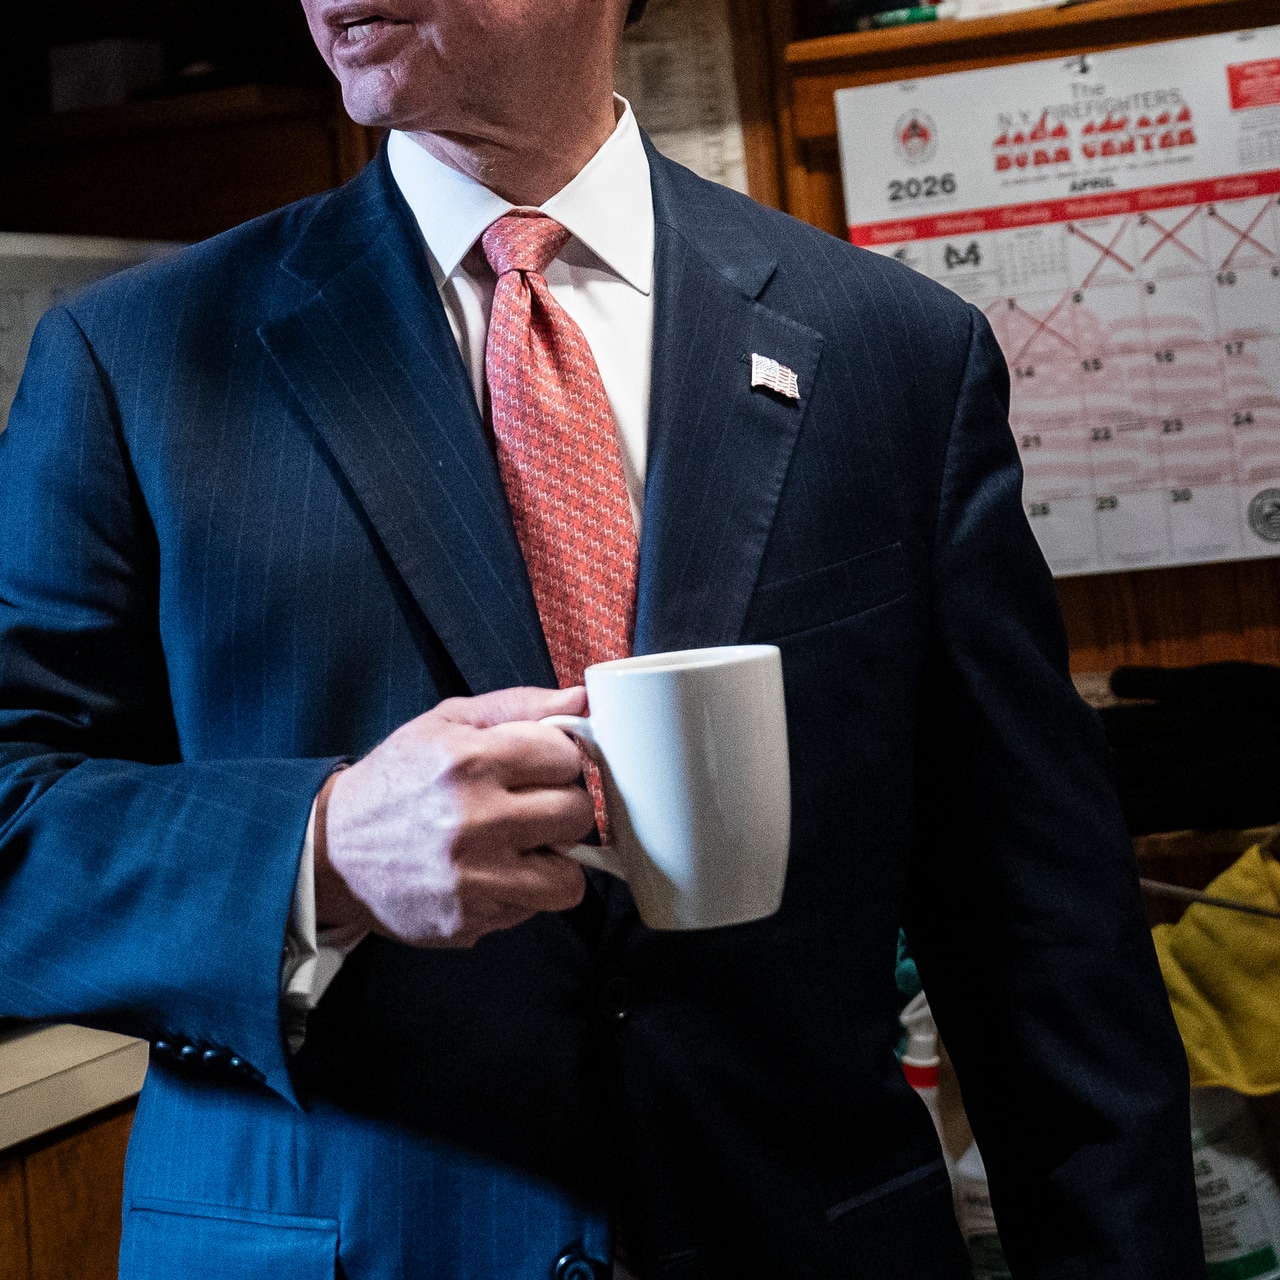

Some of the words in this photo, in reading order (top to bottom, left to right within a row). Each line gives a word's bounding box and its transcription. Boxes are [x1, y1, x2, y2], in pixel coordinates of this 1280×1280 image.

[887, 173, 957, 202] 2026
[1070, 176, 1116, 192] APRIL
[1225, 342, 1244, 356] 17
